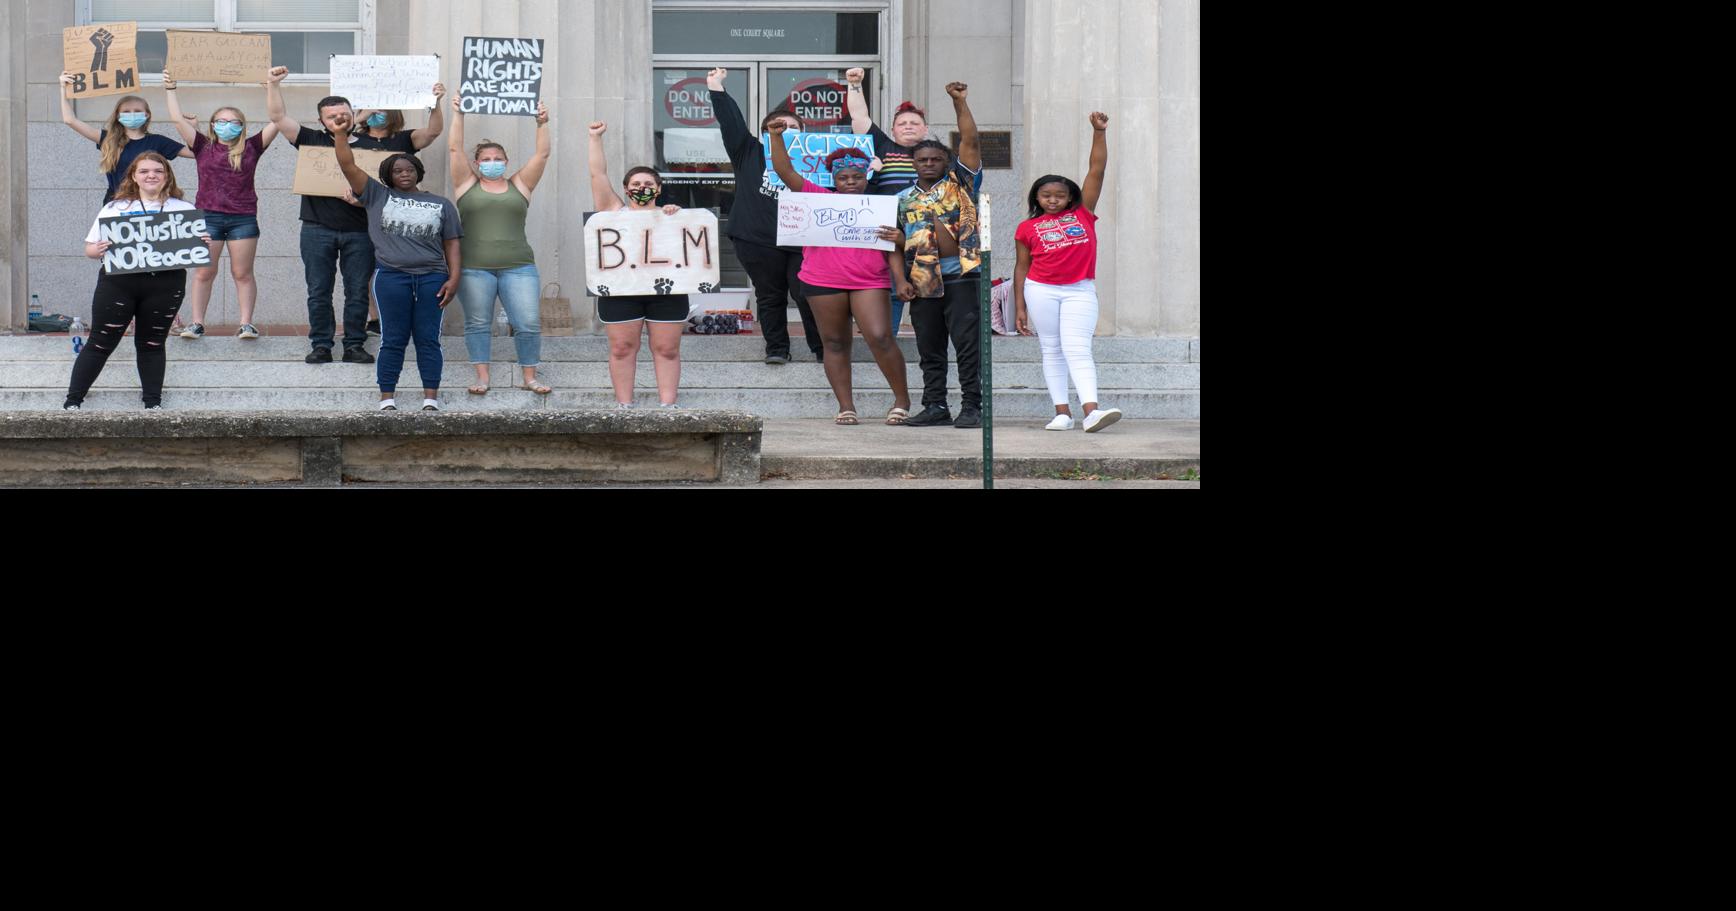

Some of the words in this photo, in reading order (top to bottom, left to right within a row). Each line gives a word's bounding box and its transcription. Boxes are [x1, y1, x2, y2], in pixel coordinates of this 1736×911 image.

[730, 29, 742, 37] ONE
[743, 29, 761, 37] COURT
[762, 29, 785, 39] SQUARE
[464, 37, 541, 59] HUMAN
[467, 57, 543, 81] RIGHTS
[72, 67, 135, 94] BLM
[460, 80, 499, 94] ARE
[500, 80, 536, 93] NOT
[460, 95, 539, 115] OPTIONAL
[668, 90, 689, 103] DO
[694, 90, 711, 103] NO
[791, 90, 812, 103] DO
[816, 90, 847, 103] NOT
[795, 106, 843, 119] ENTER
[768, 133, 877, 158] ACISM
[820, 209, 854, 224] BLM!
[99, 220, 135, 245] NO
[103, 245, 139, 273] NO
